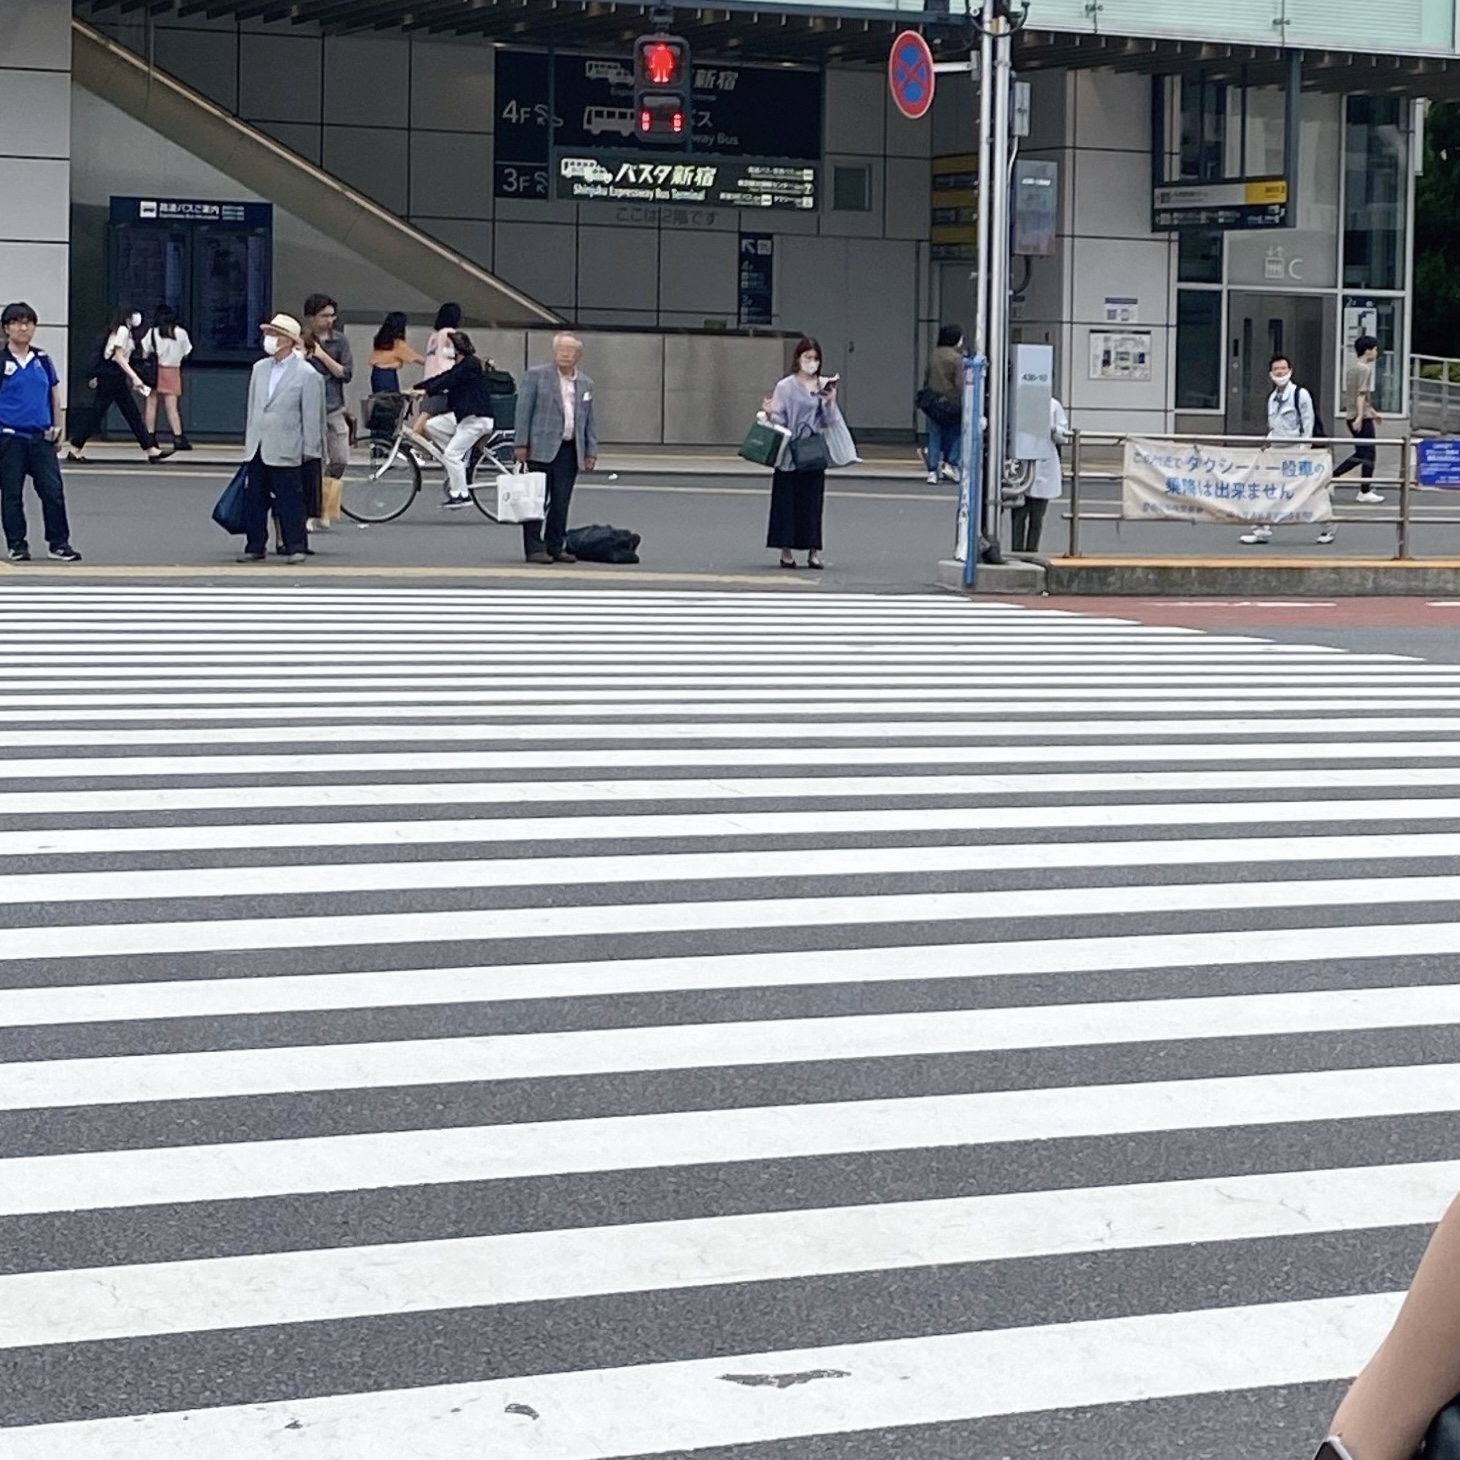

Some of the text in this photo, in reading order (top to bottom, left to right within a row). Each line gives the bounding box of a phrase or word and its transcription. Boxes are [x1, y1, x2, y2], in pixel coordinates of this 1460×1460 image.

[692, 69, 739, 91] 新宿
[502, 100, 531, 125] 4F
[502, 167, 531, 193] 3F
[614, 163, 718, 188] バスタ新宿
[1164, 476, 1295, 502] 乗降は出来ません
